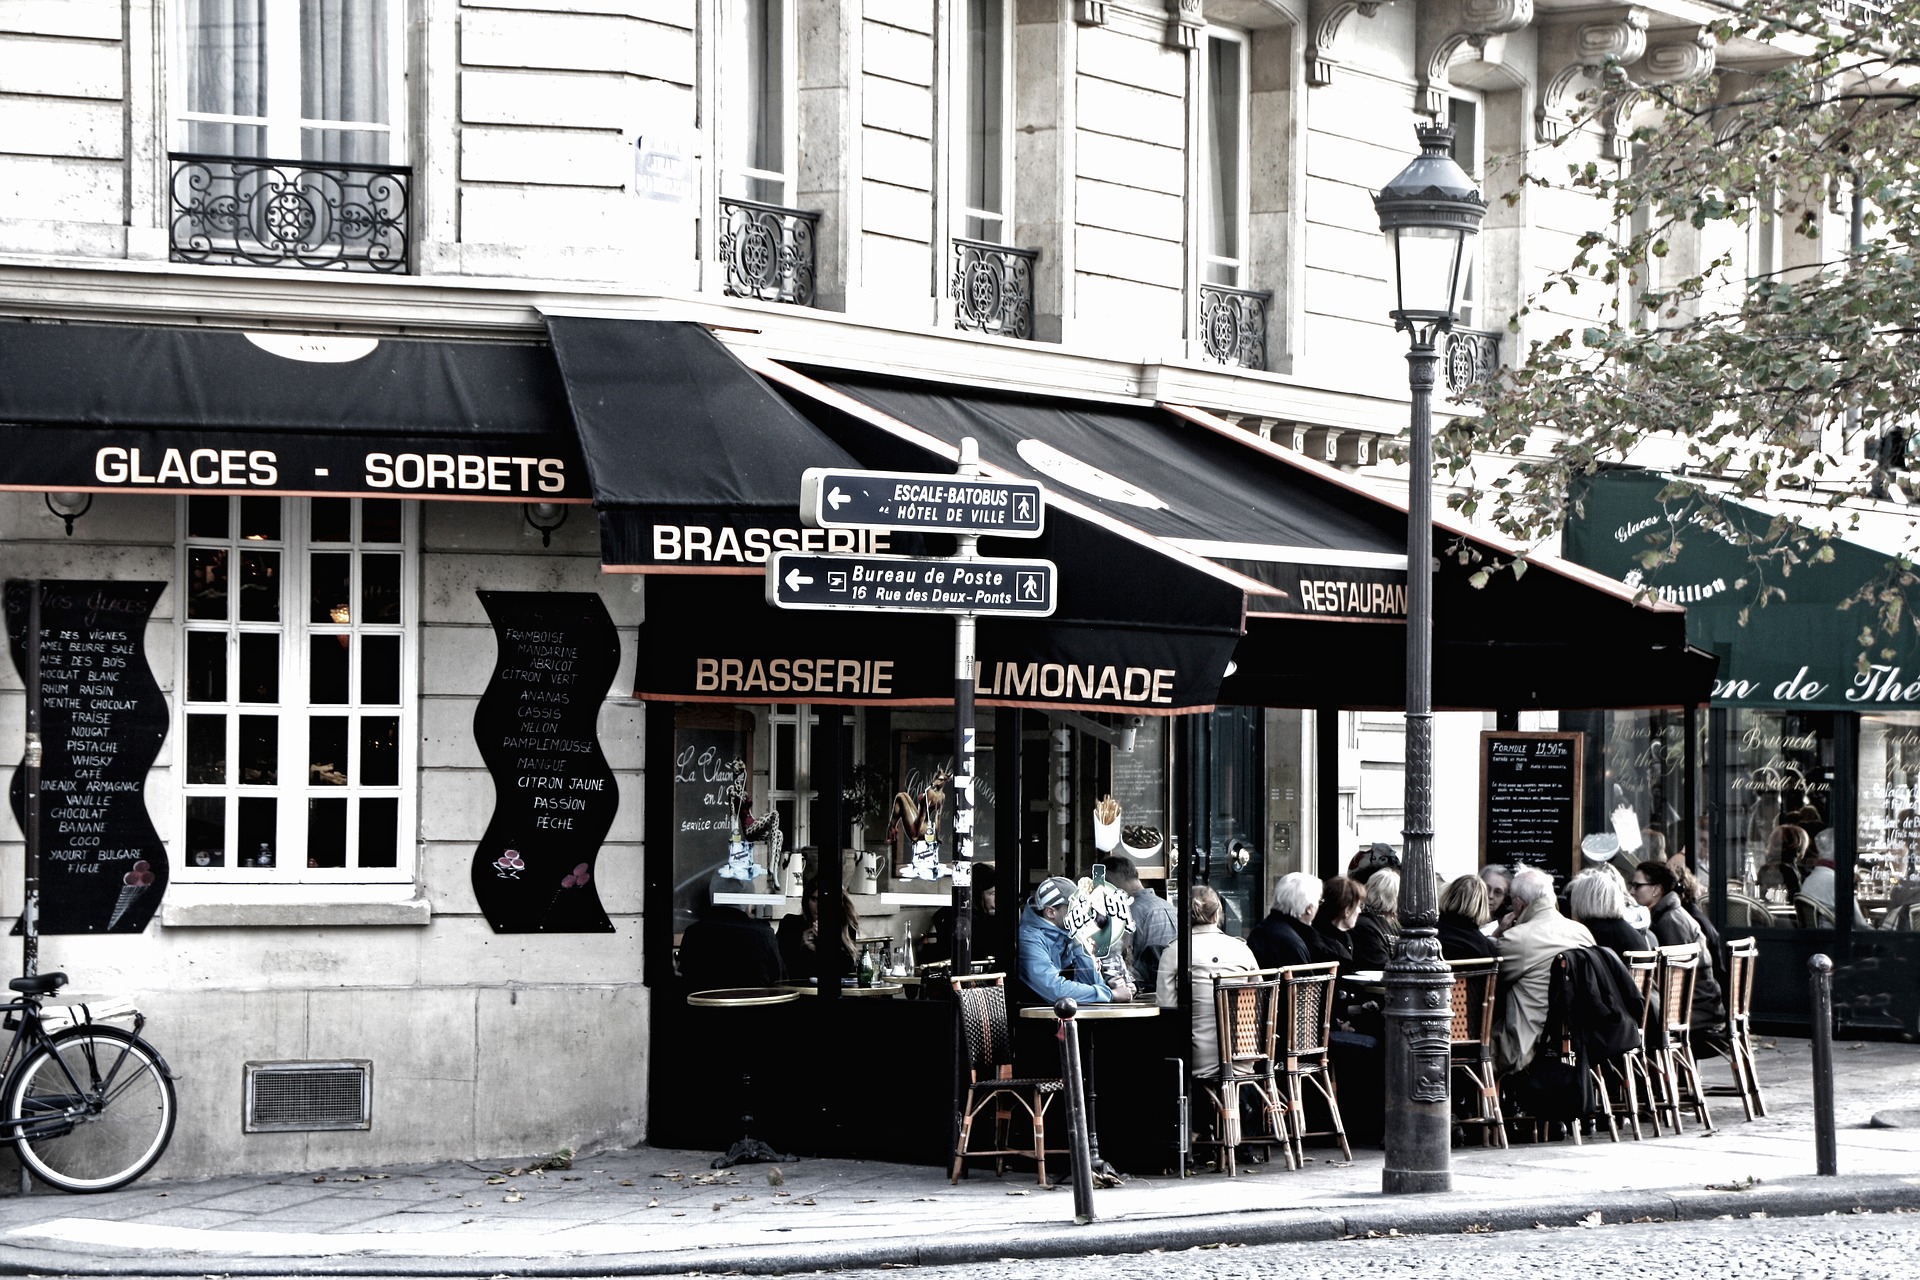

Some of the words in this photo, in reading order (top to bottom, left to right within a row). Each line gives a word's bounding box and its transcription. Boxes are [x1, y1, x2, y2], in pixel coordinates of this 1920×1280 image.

[95, 446, 278, 487] GLACES
[365, 452, 566, 493] SORBETS
[894, 484, 1008, 506] ESCALE-BATOBUS
[898, 502, 938, 521] HÔTEL
[946, 508, 962, 522] DE
[971, 510, 1005, 524] VILLE
[1615, 515, 1660, 543] Glaces
[652, 524, 892, 562] BRASSERIE
[852, 565, 917, 584] Bureau
[924, 567, 944, 584] de
[952, 569, 1003, 586] Poste
[852, 586, 867, 600] 16
[875, 588, 901, 601] Rue
[905, 589, 929, 602] des
[932, 590, 1012, 604] Deux-Ponts
[1299, 579, 1408, 615] RESTAURAN
[60, 631, 80, 640] DES
[506, 628, 565, 644] FRAMBOISE
[69, 642, 106, 653] BEURRE
[517, 644, 578, 659] MANDARINE
[71, 655, 93, 666] DES
[102, 655, 126, 668] BOIS
[530, 658, 574, 671] ABRICOT
[40, 669, 80, 680] HOCOLAT
[88, 670, 120, 682] BLANC
[501, 667, 542, 683] CITRON
[551, 673, 579, 685] VERT
[696, 658, 895, 695] BRASSERIE
[974, 661, 1176, 703] LIMONADE
[42, 684, 69, 695] RHUM
[79, 684, 114, 696] RAISIN
[1773, 665, 1829, 701] de
[43, 697, 82, 709] MENTHE
[90, 699, 138, 710] CHOCOLAT
[520, 690, 570, 704] ANANAS
[71, 711, 112, 724] FRAISE
[518, 706, 562, 720] CASSIS
[71, 726, 110, 738] NOUGAT
[520, 722, 559, 734] MELON
[66, 740, 118, 753] PISTACHE
[503, 736, 593, 754] PAMPLEMOUSSE
[1738, 727, 1817, 752] Brunch
[1492, 742, 1527, 753] FORMULE
[72, 755, 113, 767] WHISKY
[517, 757, 567, 772] MANGUE
[1763, 754, 1799, 774] from
[75, 769, 102, 780] CAFÉ
[86, 781, 140, 792] ARMAGNAC
[517, 774, 563, 790] CITRON
[569, 777, 605, 791] JAUNE
[66, 793, 112, 806] VANILLE
[533, 796, 586, 811] PASSION
[51, 808, 107, 819] CHOCOLAT
[58, 822, 108, 833] BANANE
[681, 818, 711, 832] service
[69, 836, 100, 846] COCO
[49, 849, 90, 861] YAOURT
[98, 849, 143, 861] BULGARE
[68, 862, 100, 873] FIGUE
